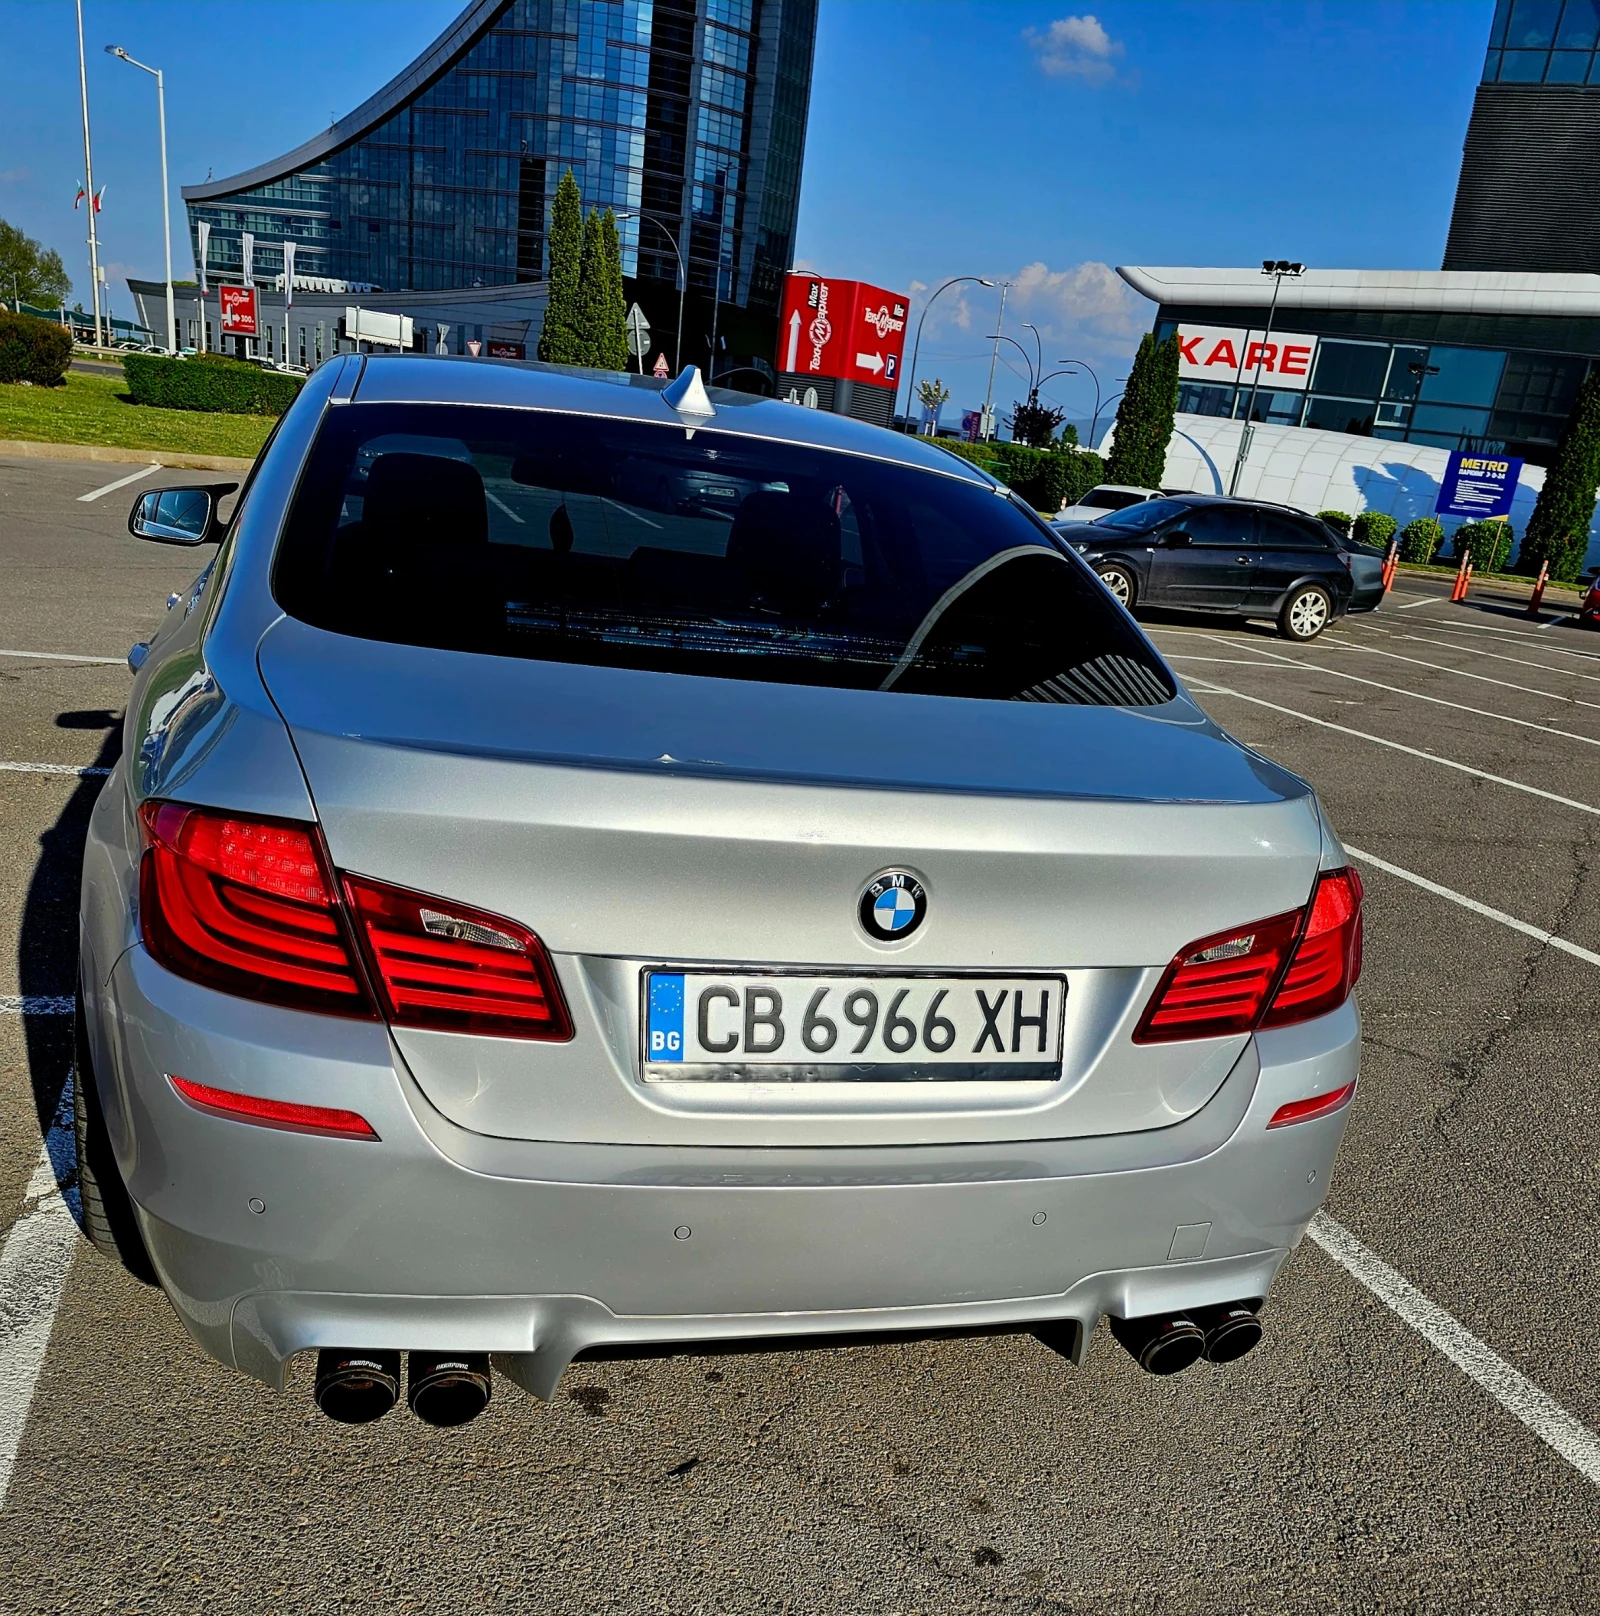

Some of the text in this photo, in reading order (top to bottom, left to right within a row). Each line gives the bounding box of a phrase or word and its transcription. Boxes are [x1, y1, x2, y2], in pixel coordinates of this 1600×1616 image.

[808, 283, 819, 307] Max
[887, 358, 895, 375] P
[1177, 335, 1311, 375] KARE
[1460, 457, 1509, 473] METRO
[869, 875, 924, 899] BMW
[697, 984, 1050, 1054] CB 6966 XH
[651, 1030, 680, 1051] BG
